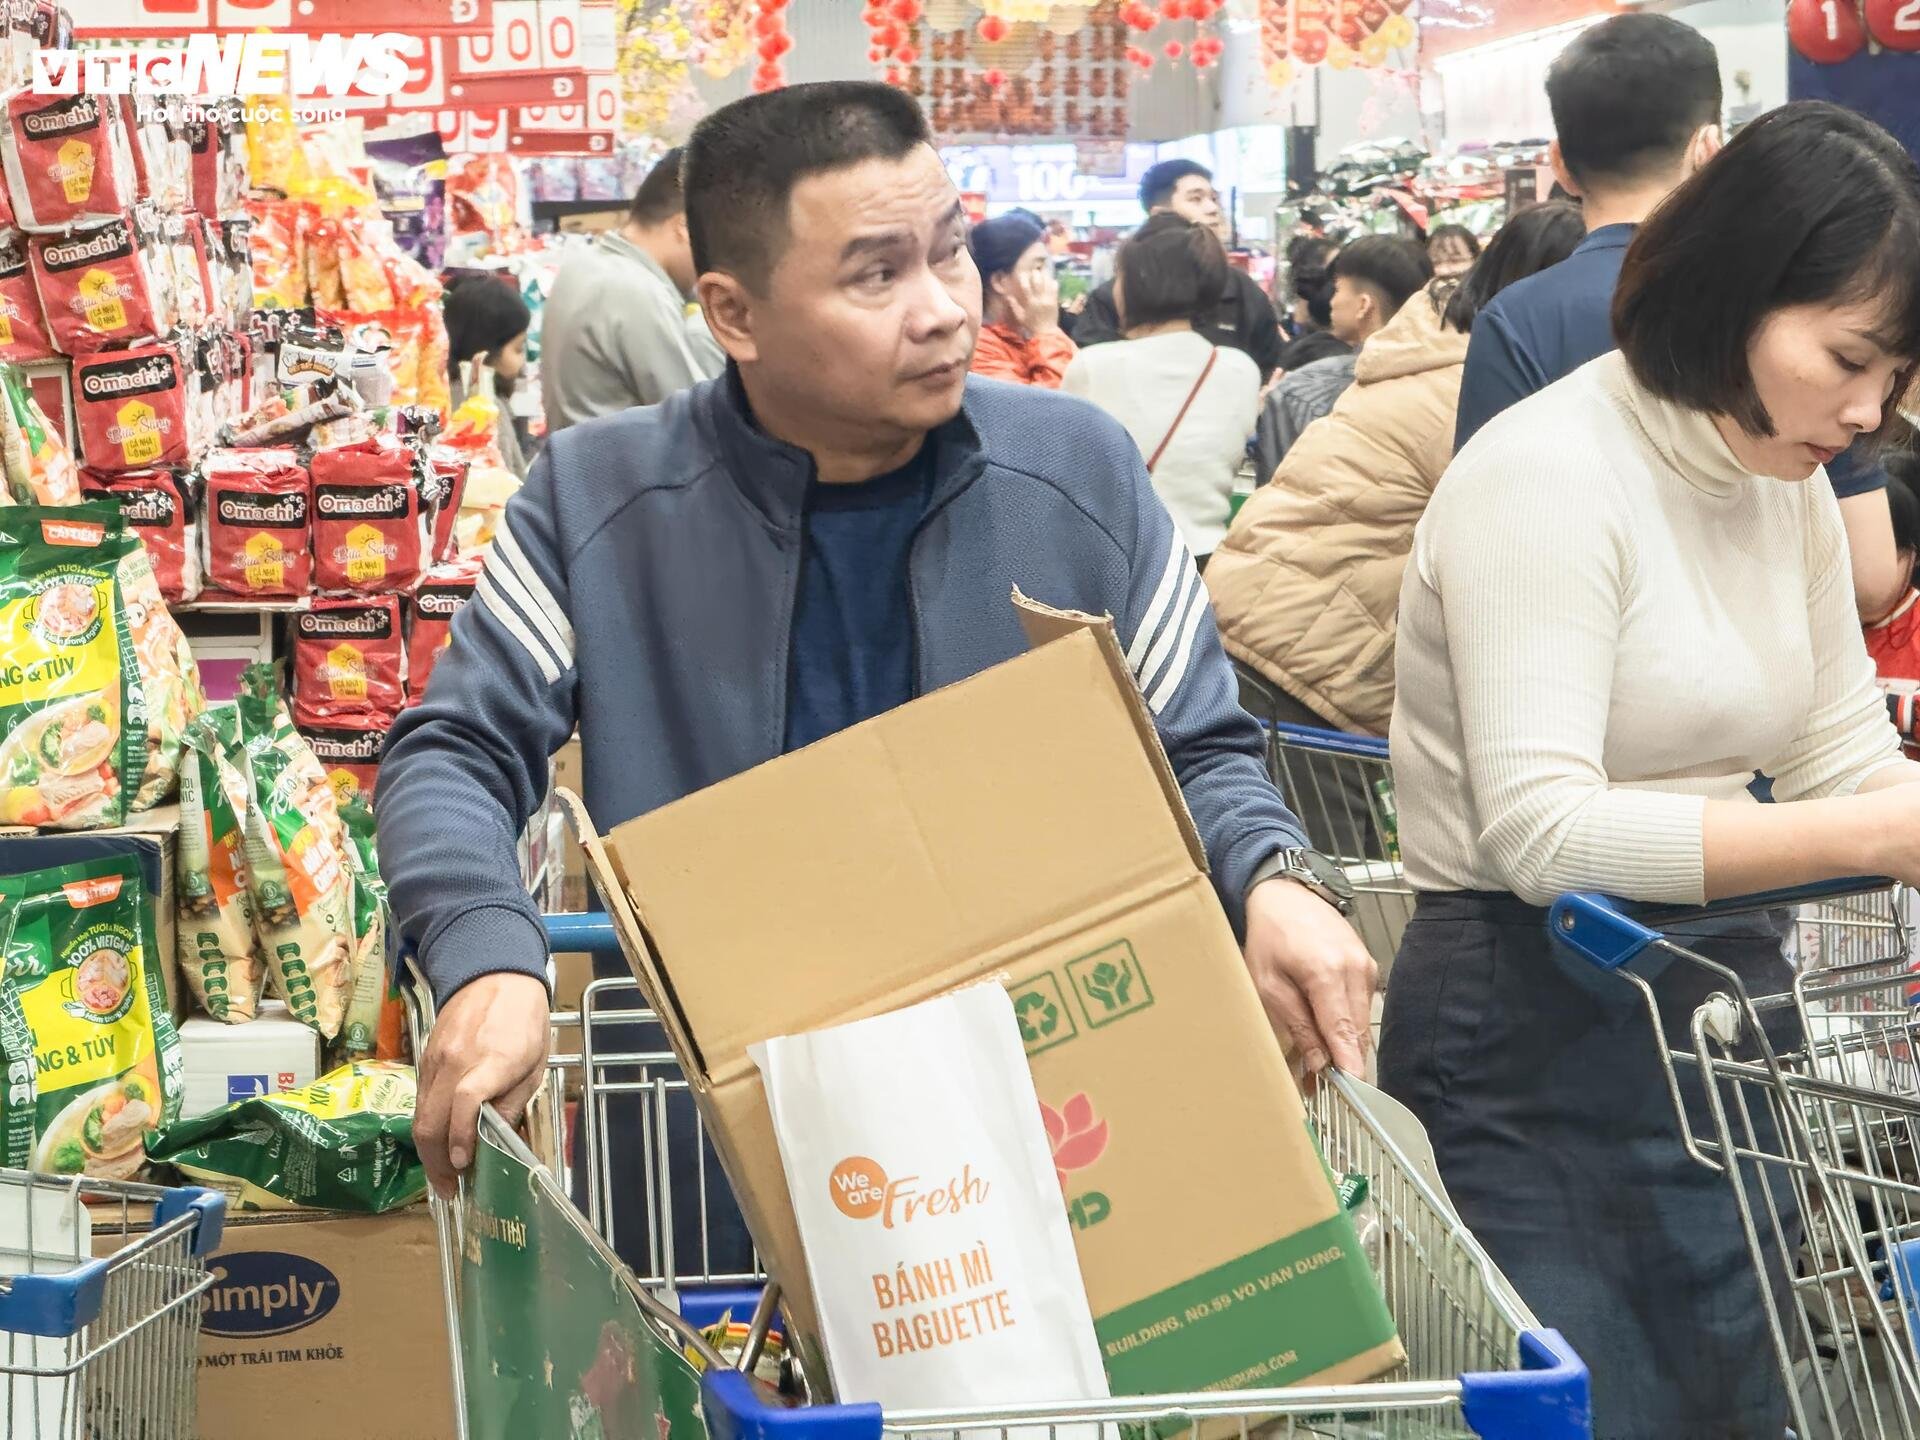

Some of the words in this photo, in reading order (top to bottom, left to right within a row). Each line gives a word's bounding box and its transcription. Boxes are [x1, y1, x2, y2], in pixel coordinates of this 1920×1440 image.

[1820, 0, 1838, 40] 1
[25, 103, 96, 132] Omachi
[44, 232, 119, 265] Omachi
[84, 366, 160, 394] Omachi
[119, 501, 157, 520] achi
[220, 500, 294, 522] Omachi
[318, 493, 394, 514] Omachi
[300, 614, 376, 632] Omachi
[67, 938, 97, 966] 100%
[66, 1045, 82, 1066] &
[82, 1033, 116, 1061] TỦY
[834, 1171, 870, 1192] We
[847, 1188, 883, 1206] are
[882, 1164, 990, 1230] Fresh
[872, 1261, 958, 1310] BÁNH
[960, 1240, 993, 1289] MÌ
[872, 1289, 1017, 1359] BAGUETTE
[1106, 1316, 1184, 1357] BUILDING,
[1233, 1282, 1256, 1301] VO
[1257, 1265, 1294, 1292] VAN
[205, 1351, 237, 1369] MỘT
[240, 1348, 273, 1364] TRÁI
[276, 1349, 302, 1363] TIM
[306, 1342, 344, 1362] KHỎE
